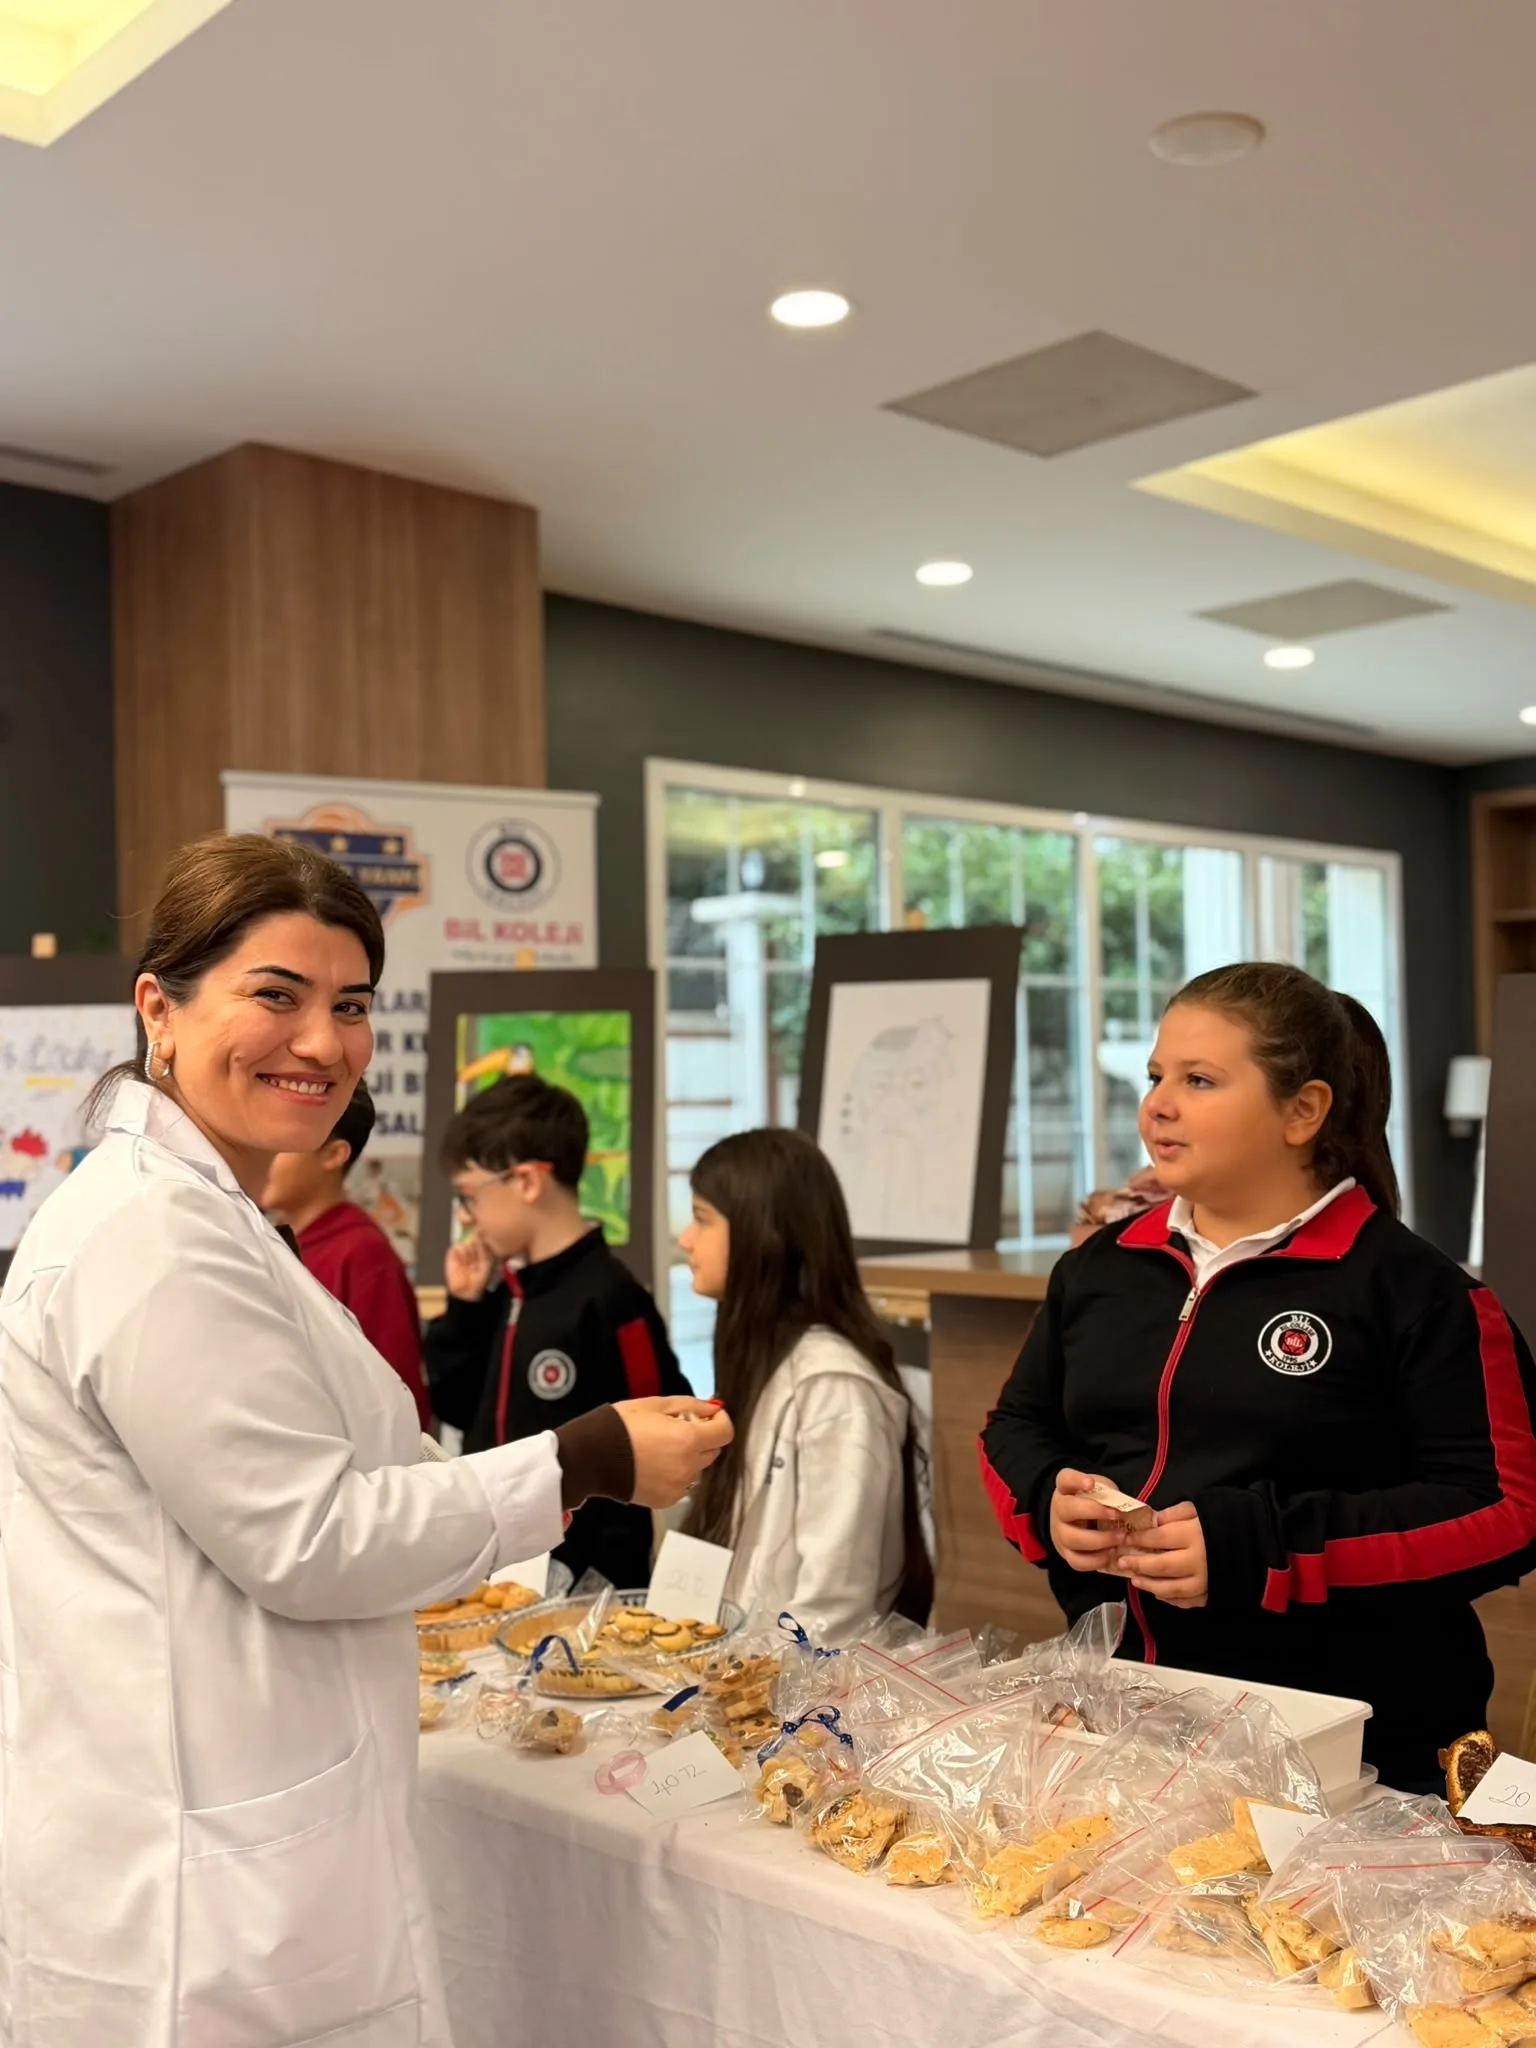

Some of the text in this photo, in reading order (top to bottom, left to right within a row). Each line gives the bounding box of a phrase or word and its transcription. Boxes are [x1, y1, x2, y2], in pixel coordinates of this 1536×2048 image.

[1291, 1315, 1311, 1324] BİL
[1269, 1356, 1312, 1371] KOLEJİ
[1487, 1785, 1532, 1808] 20
